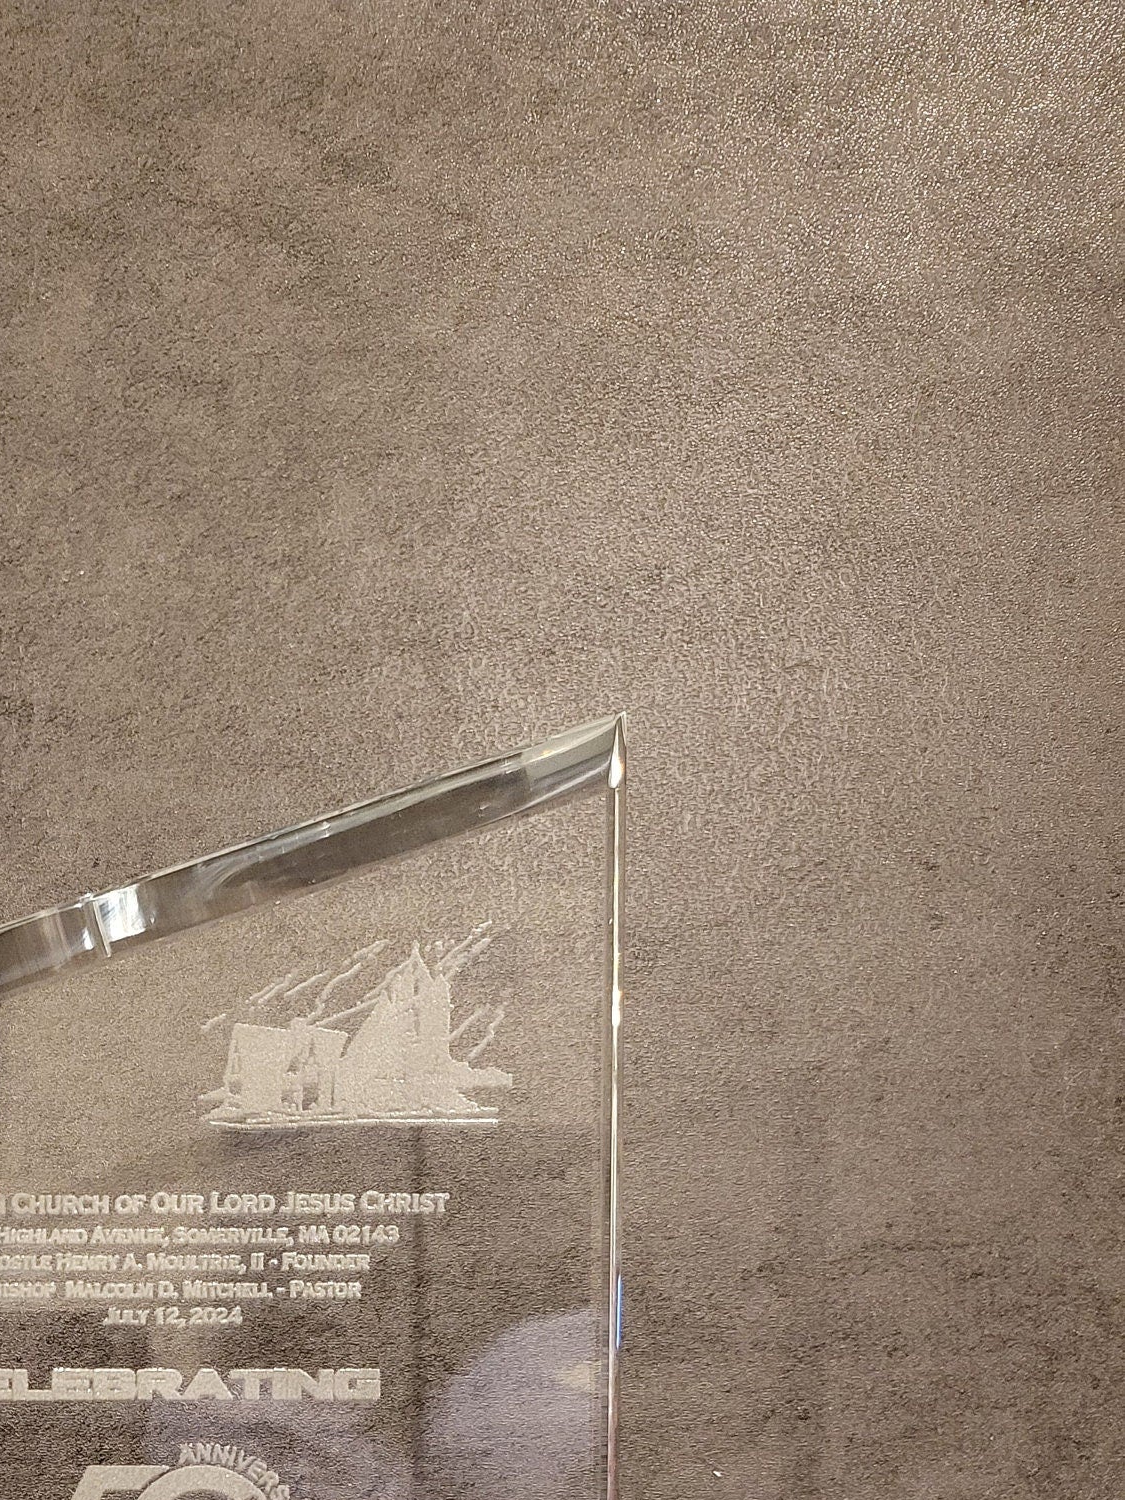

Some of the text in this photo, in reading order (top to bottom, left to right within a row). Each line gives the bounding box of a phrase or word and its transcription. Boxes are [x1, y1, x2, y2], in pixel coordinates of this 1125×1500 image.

[11, 1192, 110, 1214] CHURCH
[115, 1194, 146, 1214] OF
[150, 1192, 204, 1214] OUR
[209, 1191, 275, 1214] LORD
[279, 1191, 355, 1213] JESUS
[360, 1190, 451, 1213] CHRIST
[298, 1225, 329, 1244] MA
[289, 1279, 362, 1299] PASTOR
[103, 1306, 150, 1326] JULY
[189, 1305, 244, 1326] 2024
